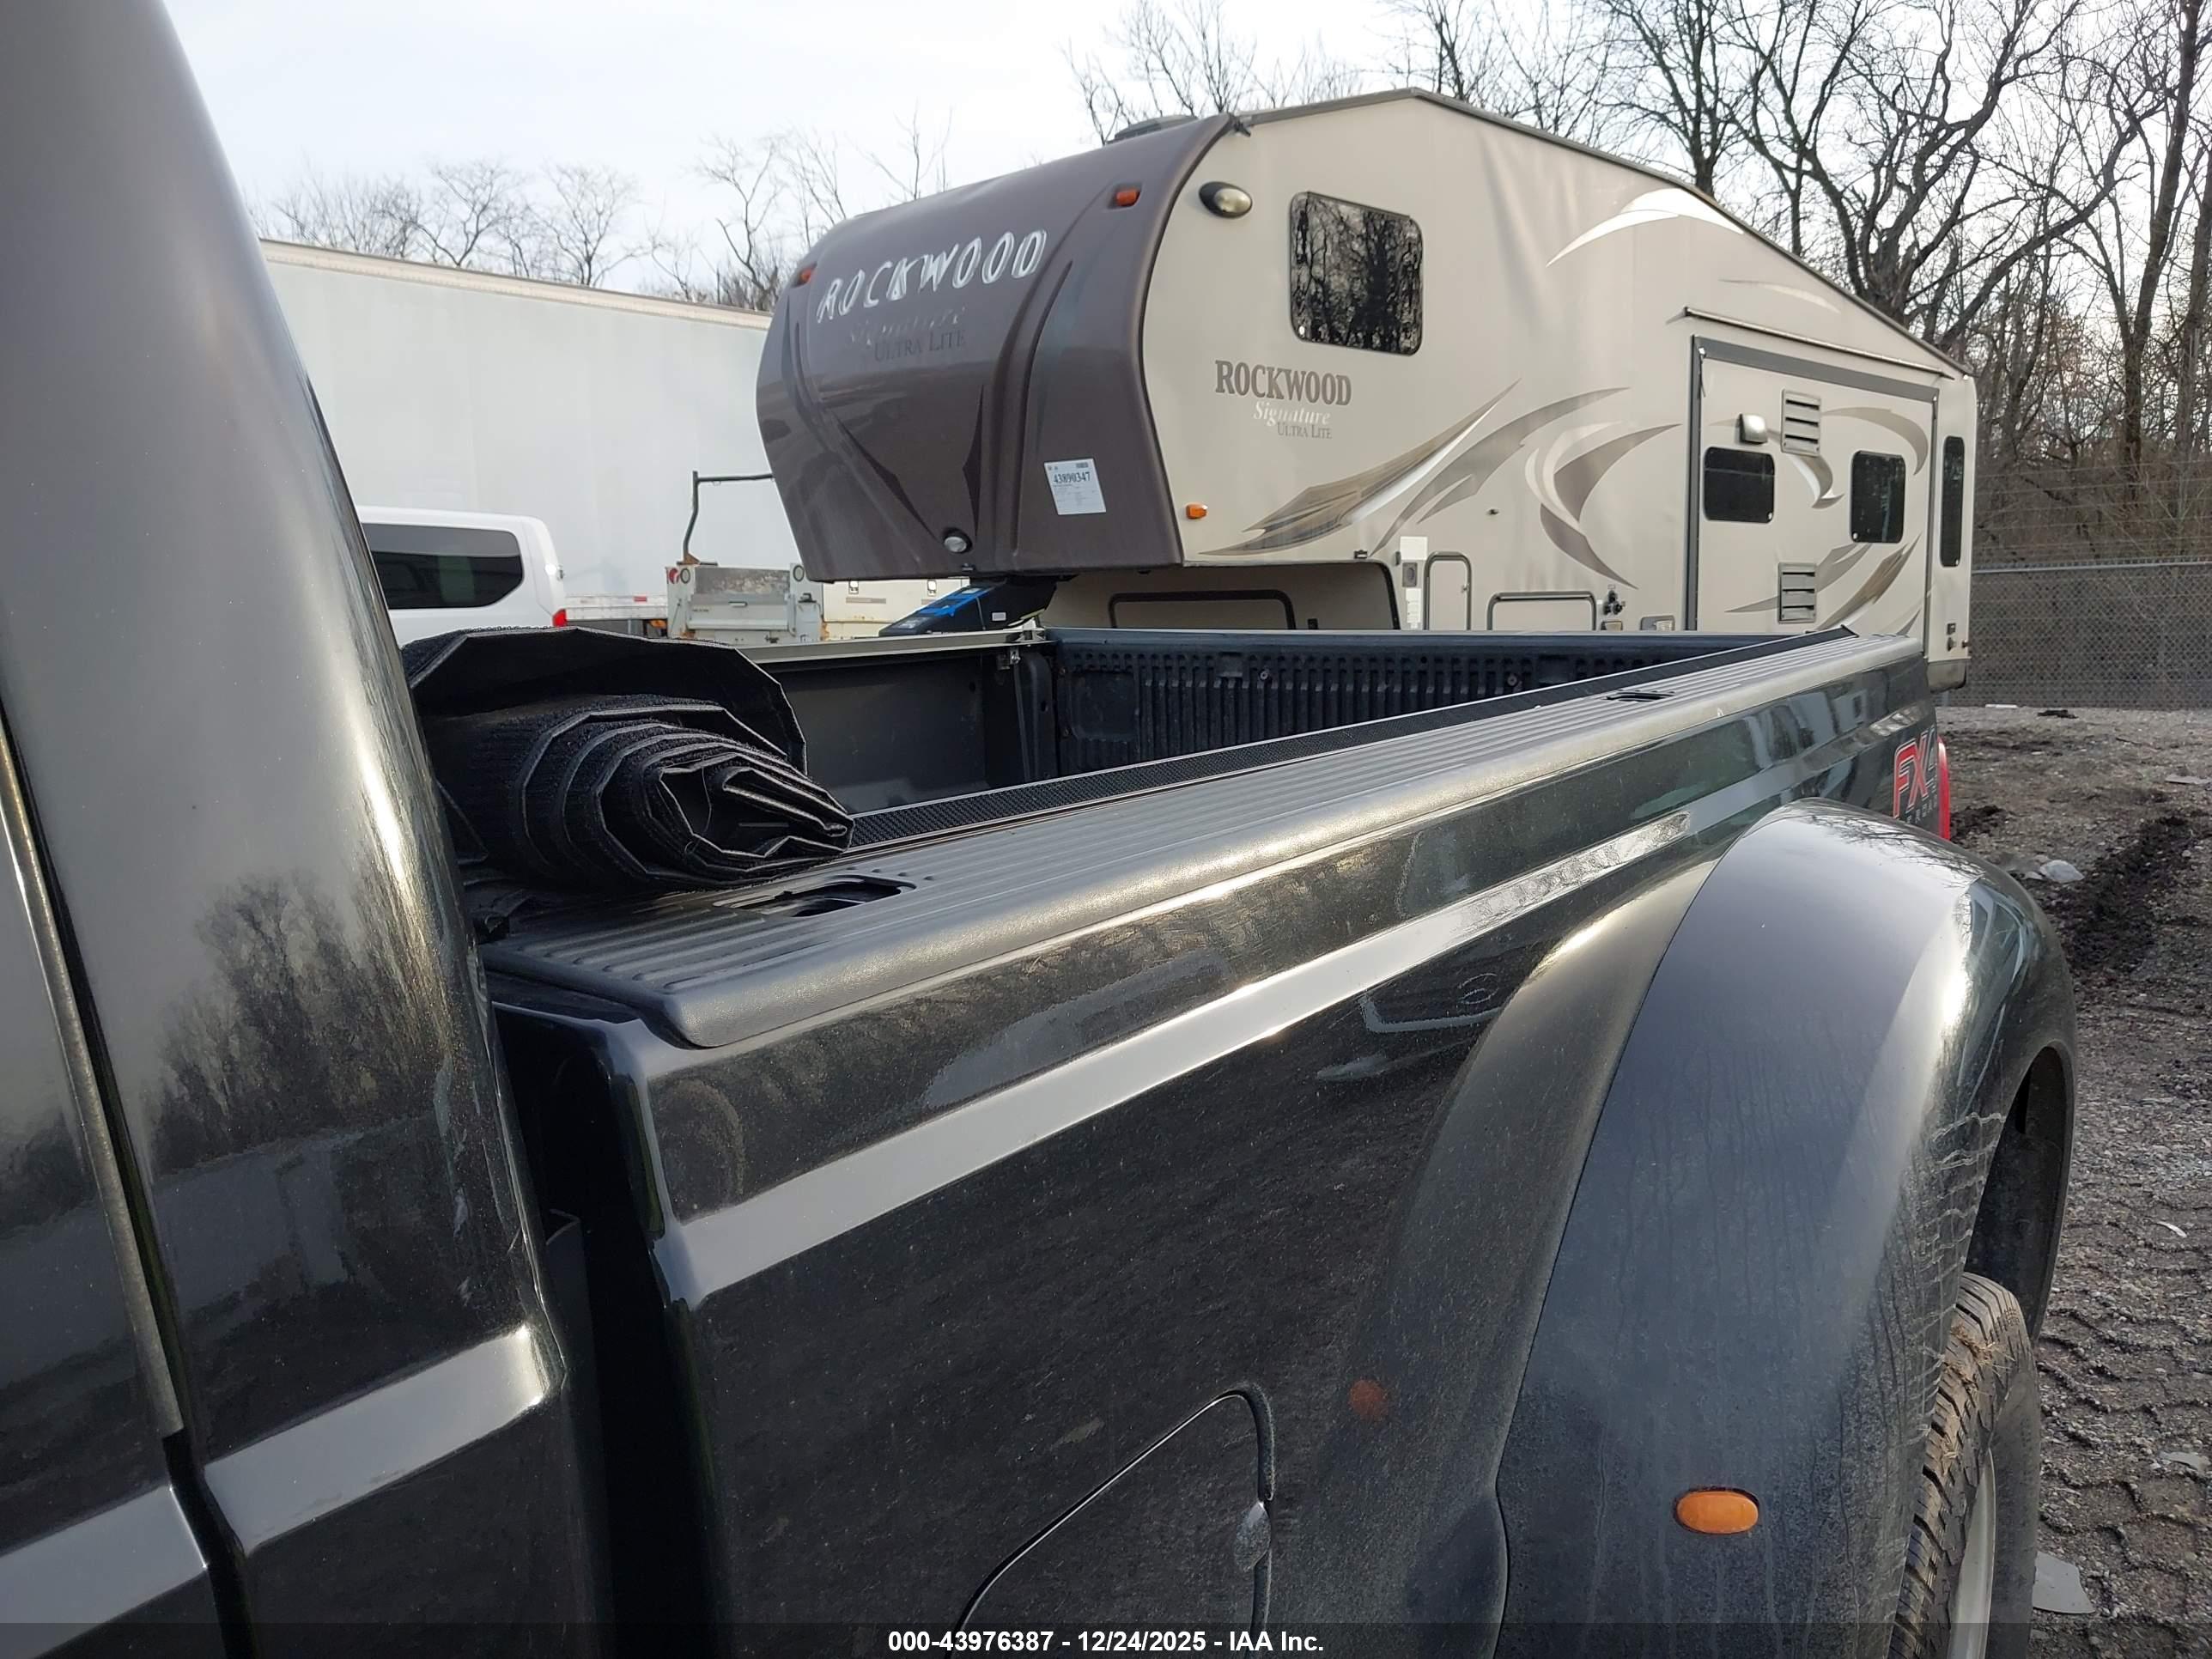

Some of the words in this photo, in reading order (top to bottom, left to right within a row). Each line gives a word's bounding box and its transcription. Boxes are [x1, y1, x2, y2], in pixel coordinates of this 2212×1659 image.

[817, 229, 1048, 324] ROCKWOOD
[929, 329, 968, 352] LITE
[1214, 360, 1352, 406] ROCKWOOD
[1253, 401, 1331, 427] Signature
[1277, 422, 1310, 439] ULTRA
[1311, 424, 1333, 439] LITE
